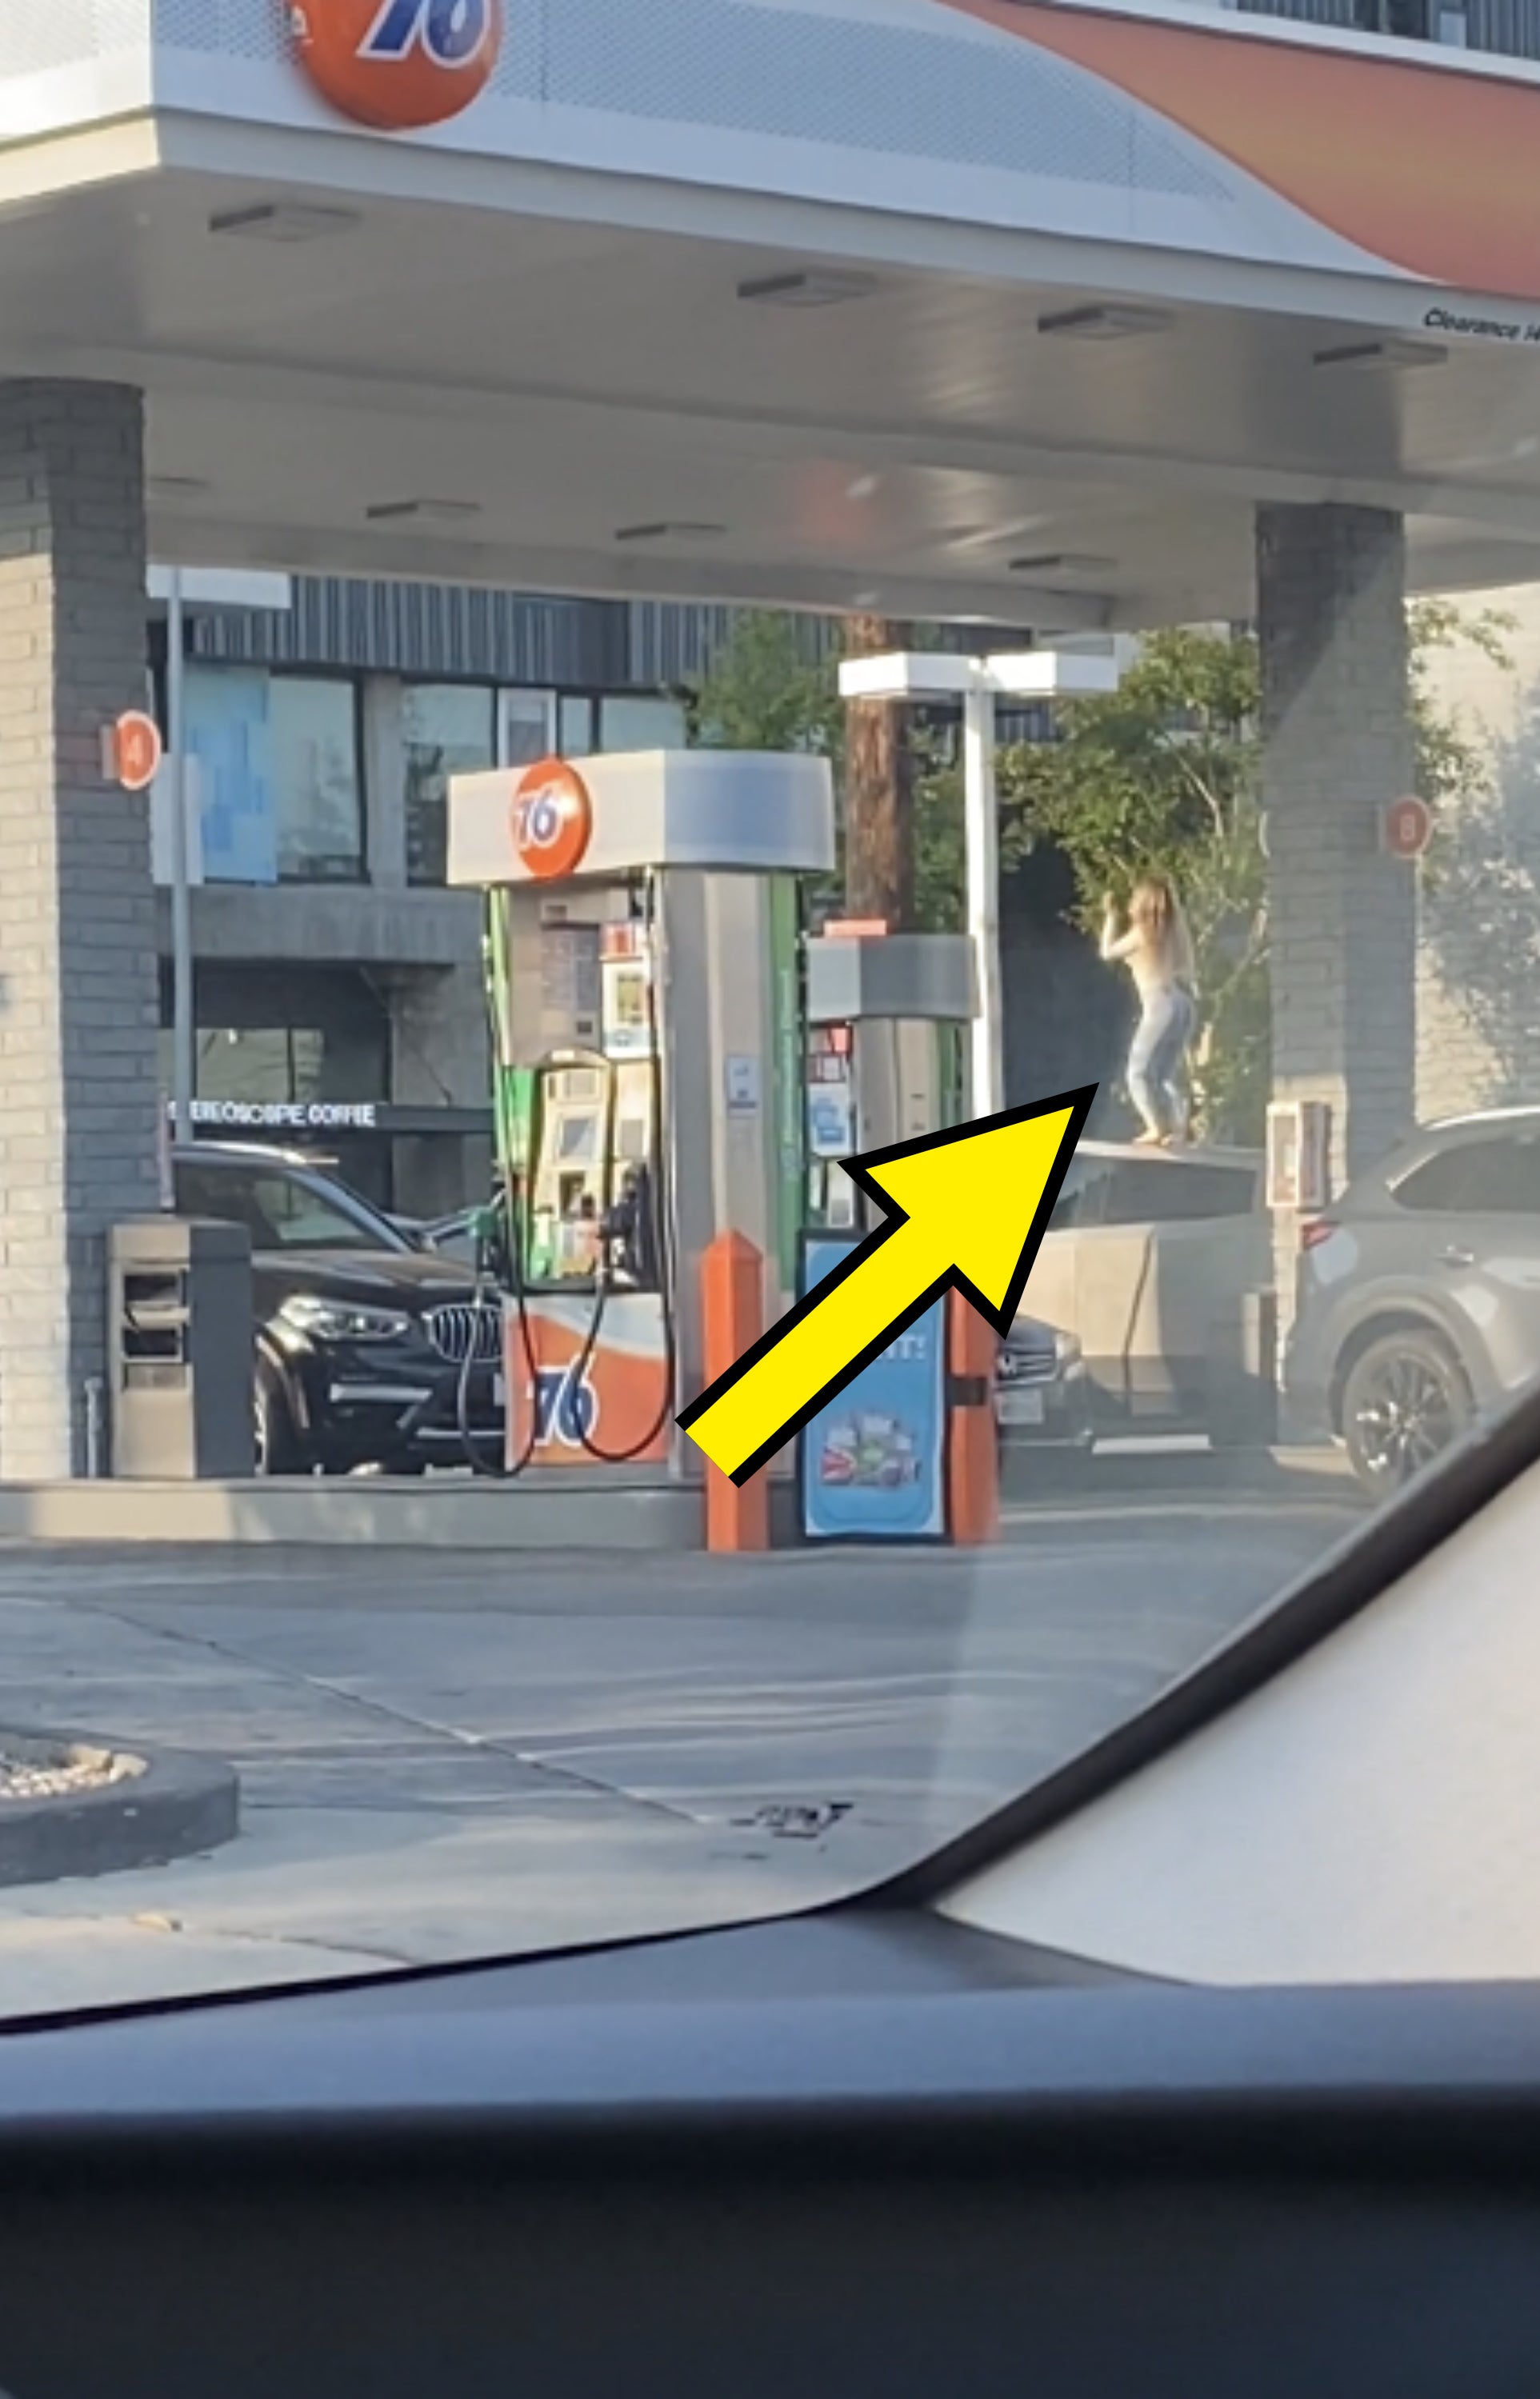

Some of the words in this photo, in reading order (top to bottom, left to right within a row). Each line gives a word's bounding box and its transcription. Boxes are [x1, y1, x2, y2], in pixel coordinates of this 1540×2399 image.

[1425, 306, 1520, 339] Clearance
[514, 781, 563, 850] 76
[526, 1350, 599, 1450] 76
